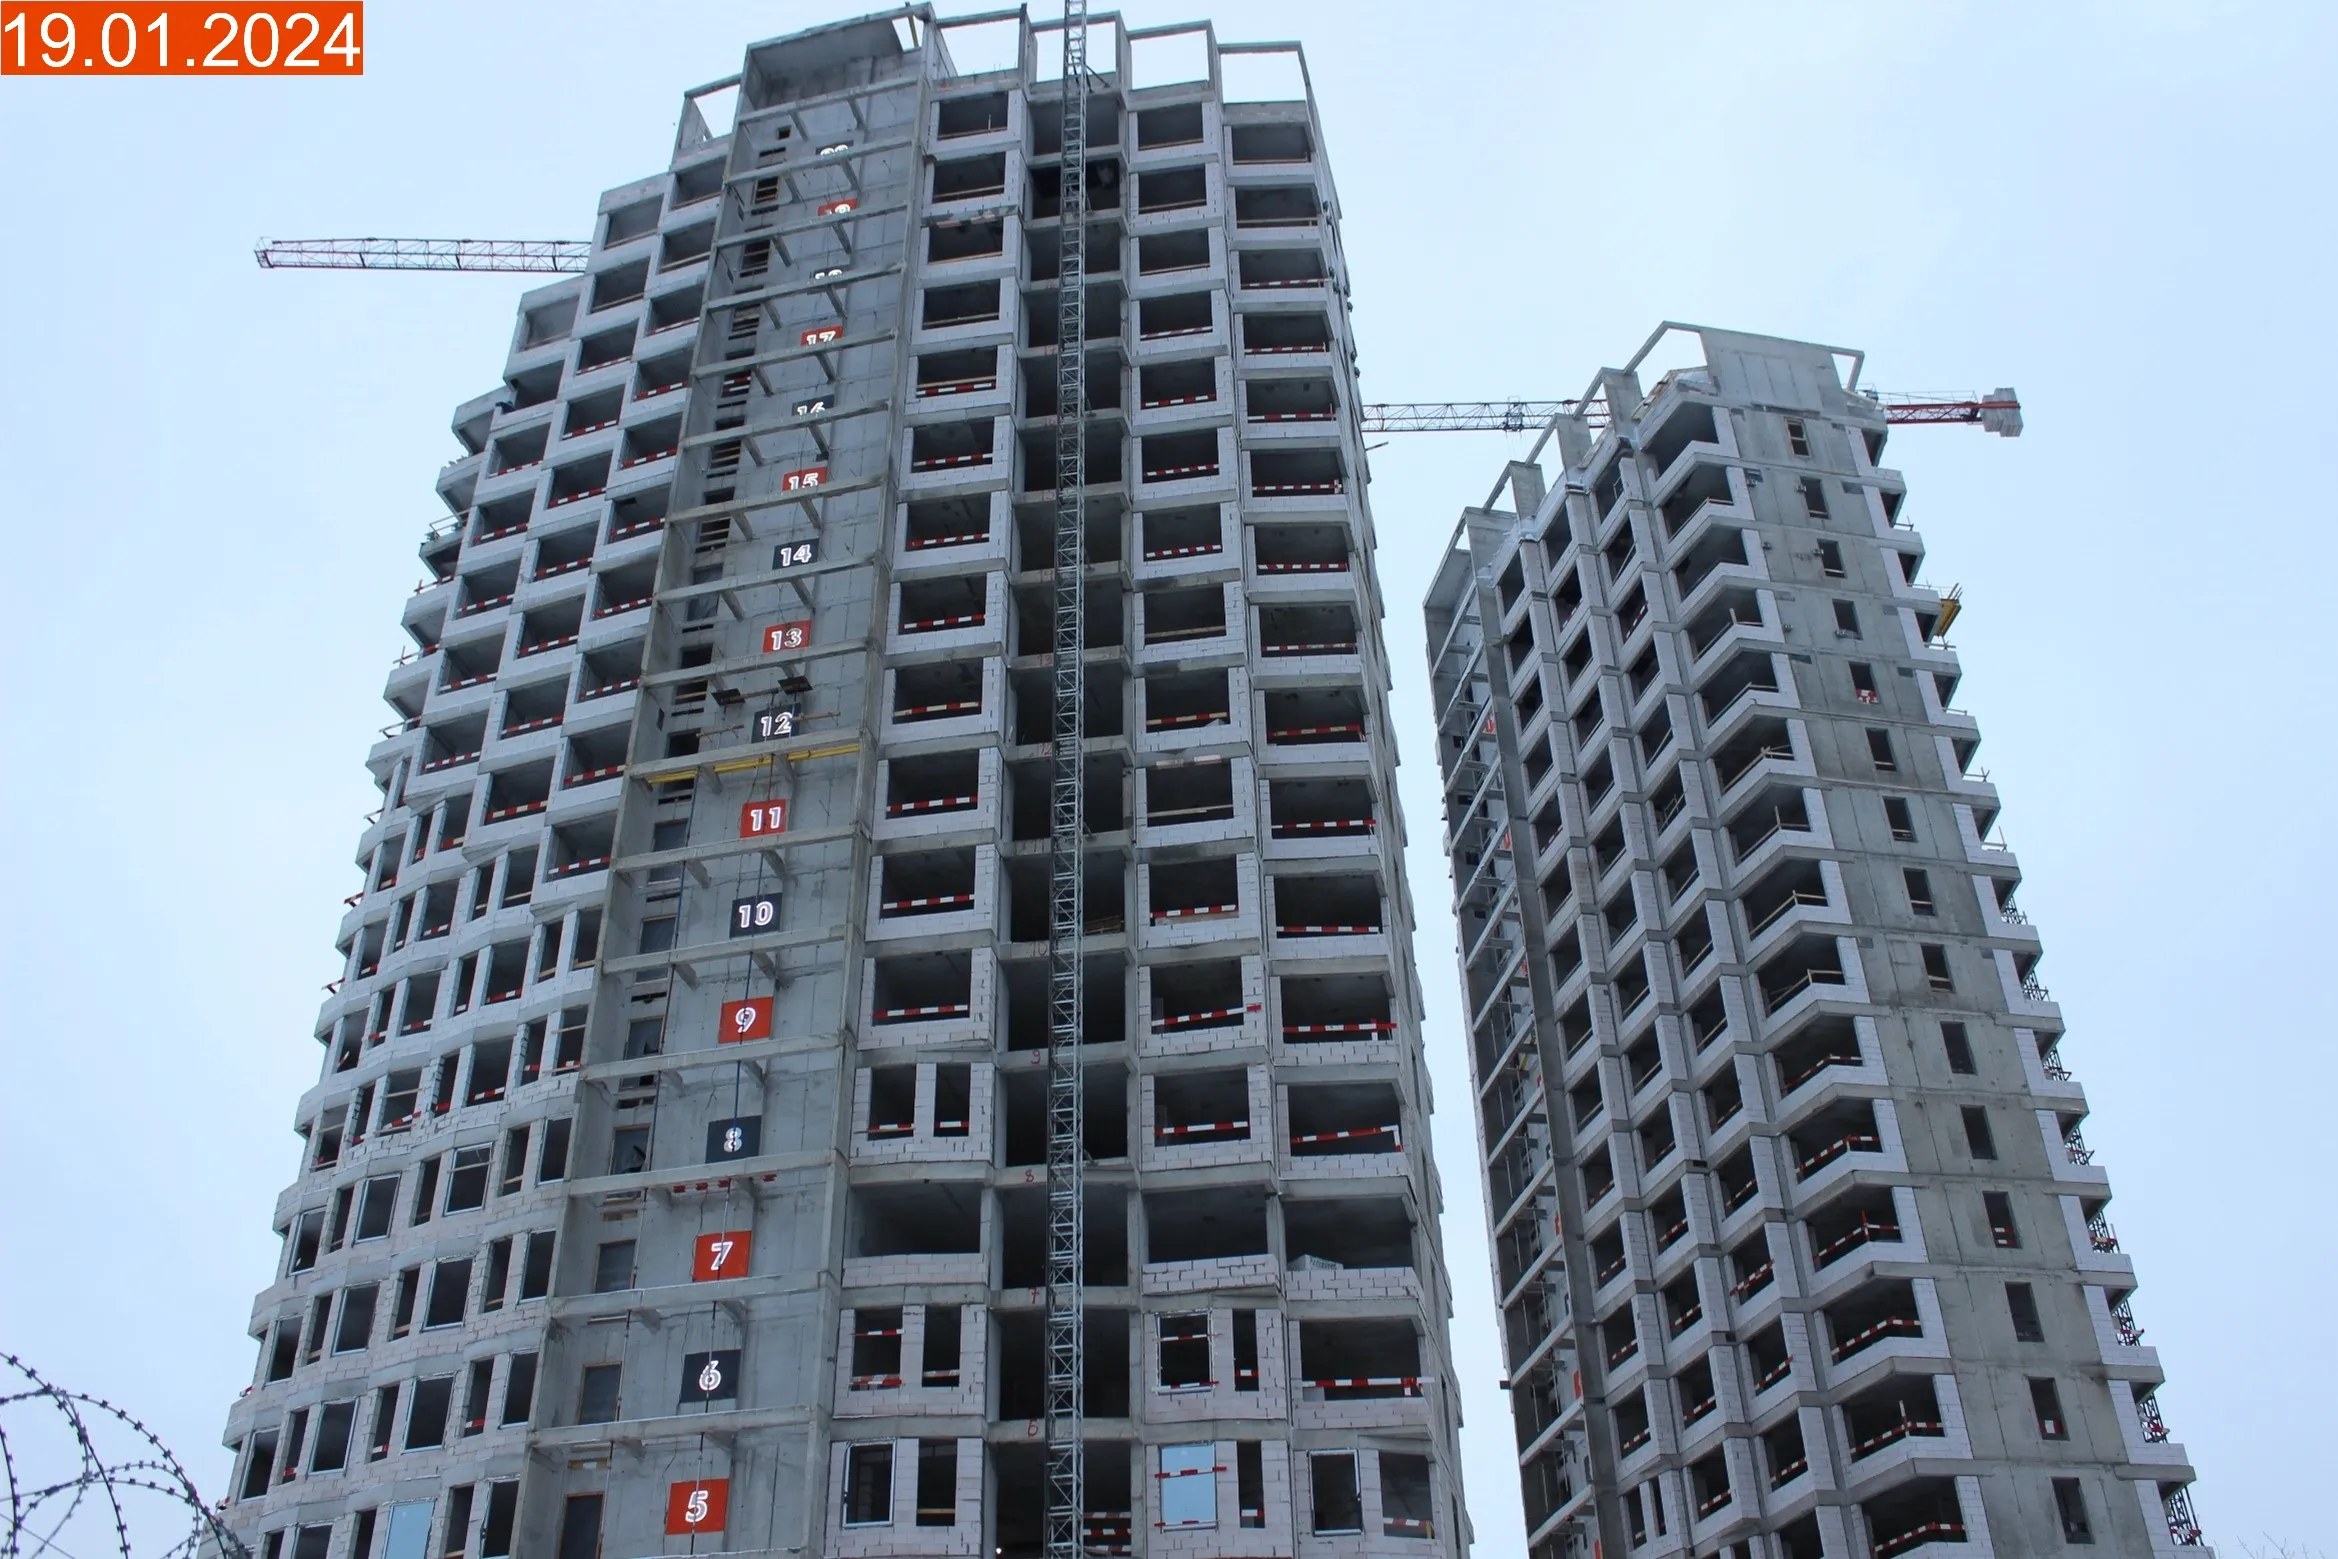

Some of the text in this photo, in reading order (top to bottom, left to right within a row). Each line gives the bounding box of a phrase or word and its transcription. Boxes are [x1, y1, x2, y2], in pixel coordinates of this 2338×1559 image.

[788, 472, 819, 491] 15
[780, 544, 812, 567] 14
[771, 628, 802, 651] 13
[760, 711, 793, 737] 12
[750, 806, 781, 832] 11
[738, 901, 774, 928] 10
[734, 1007, 756, 1033] 9
[1030, 1048, 1041, 1065] 9
[723, 1127, 743, 1152] 8
[1025, 1169, 1035, 1183] 8
[710, 1241, 733, 1271] 7
[699, 1360, 722, 1391] 6
[685, 1490, 709, 1523] 5
